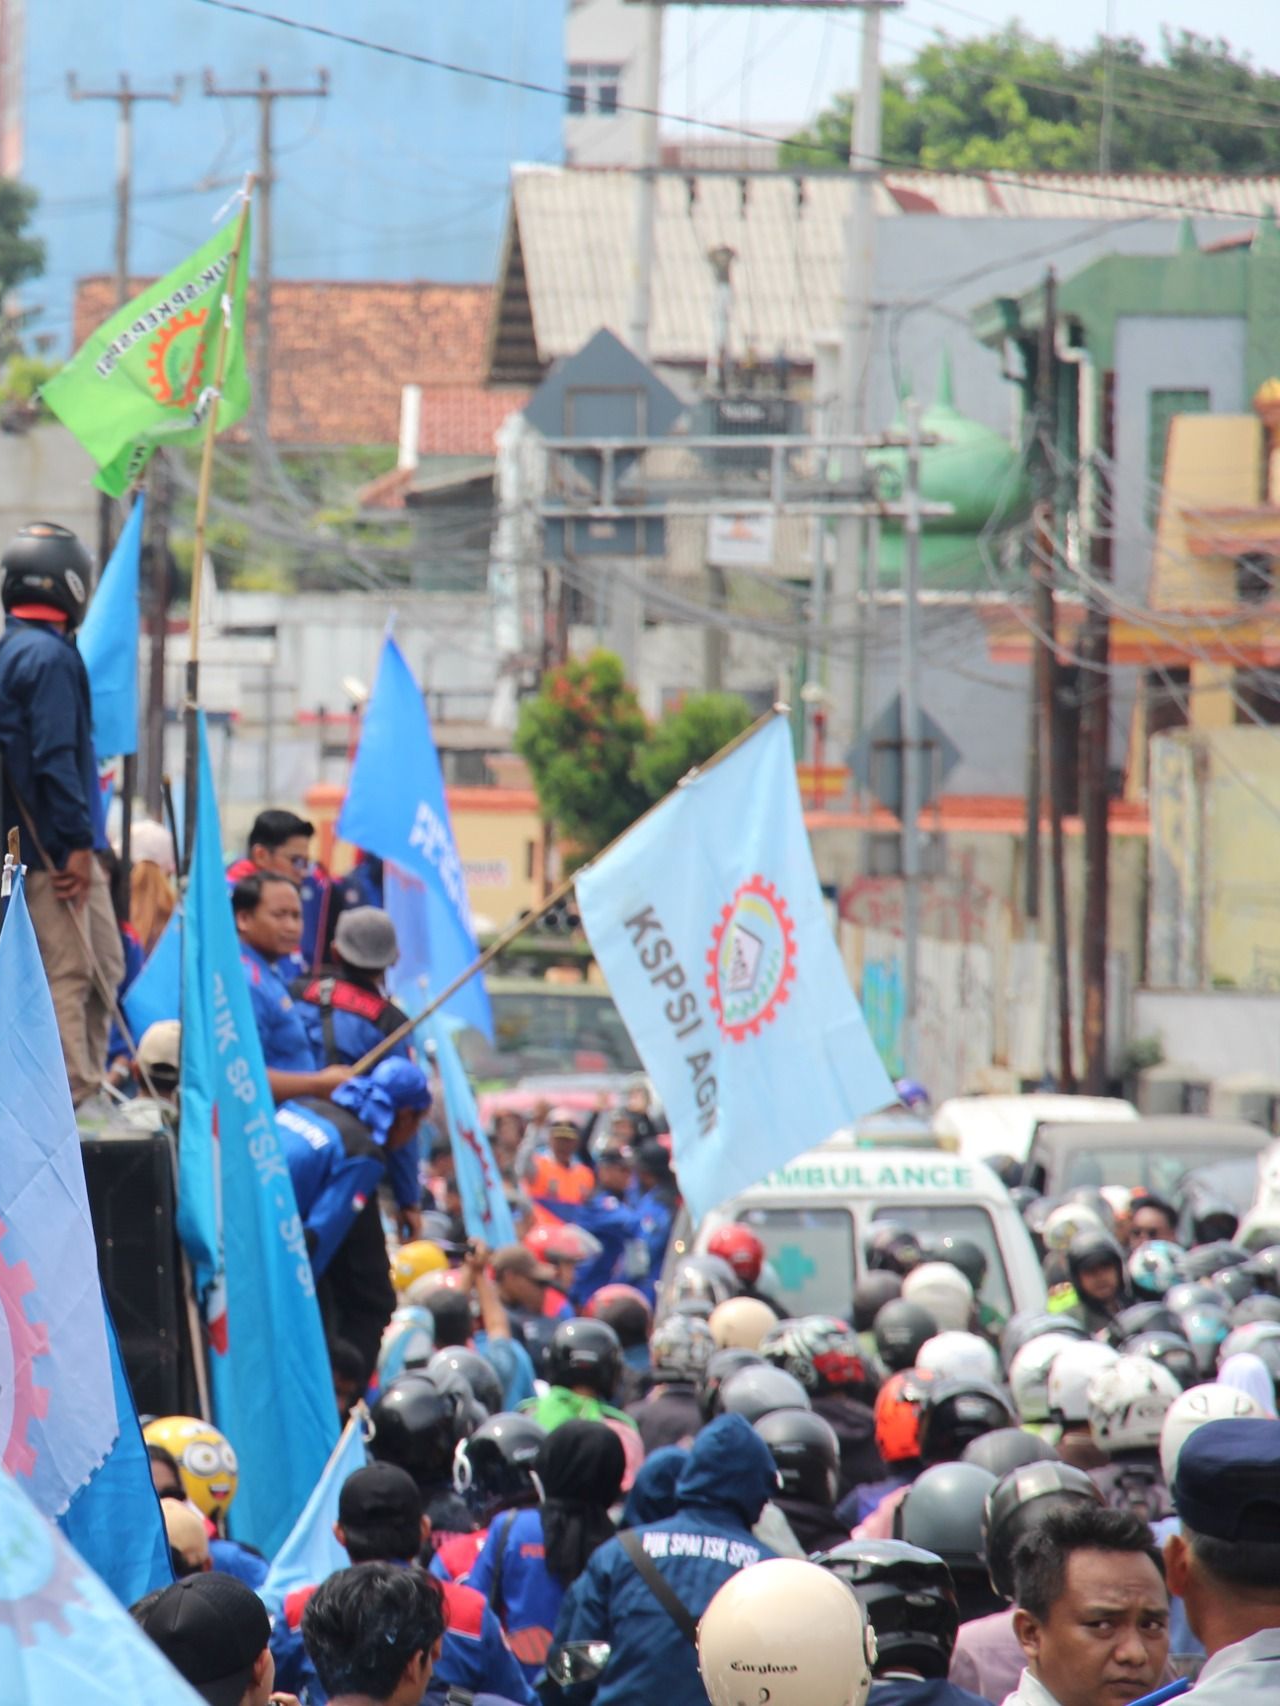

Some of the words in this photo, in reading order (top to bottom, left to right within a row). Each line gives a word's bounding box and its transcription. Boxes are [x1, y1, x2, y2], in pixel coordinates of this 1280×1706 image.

[623, 904, 703, 1040] KSPSI
[226, 1056, 256, 1104] SP
[244, 1111, 287, 1185] TSK
